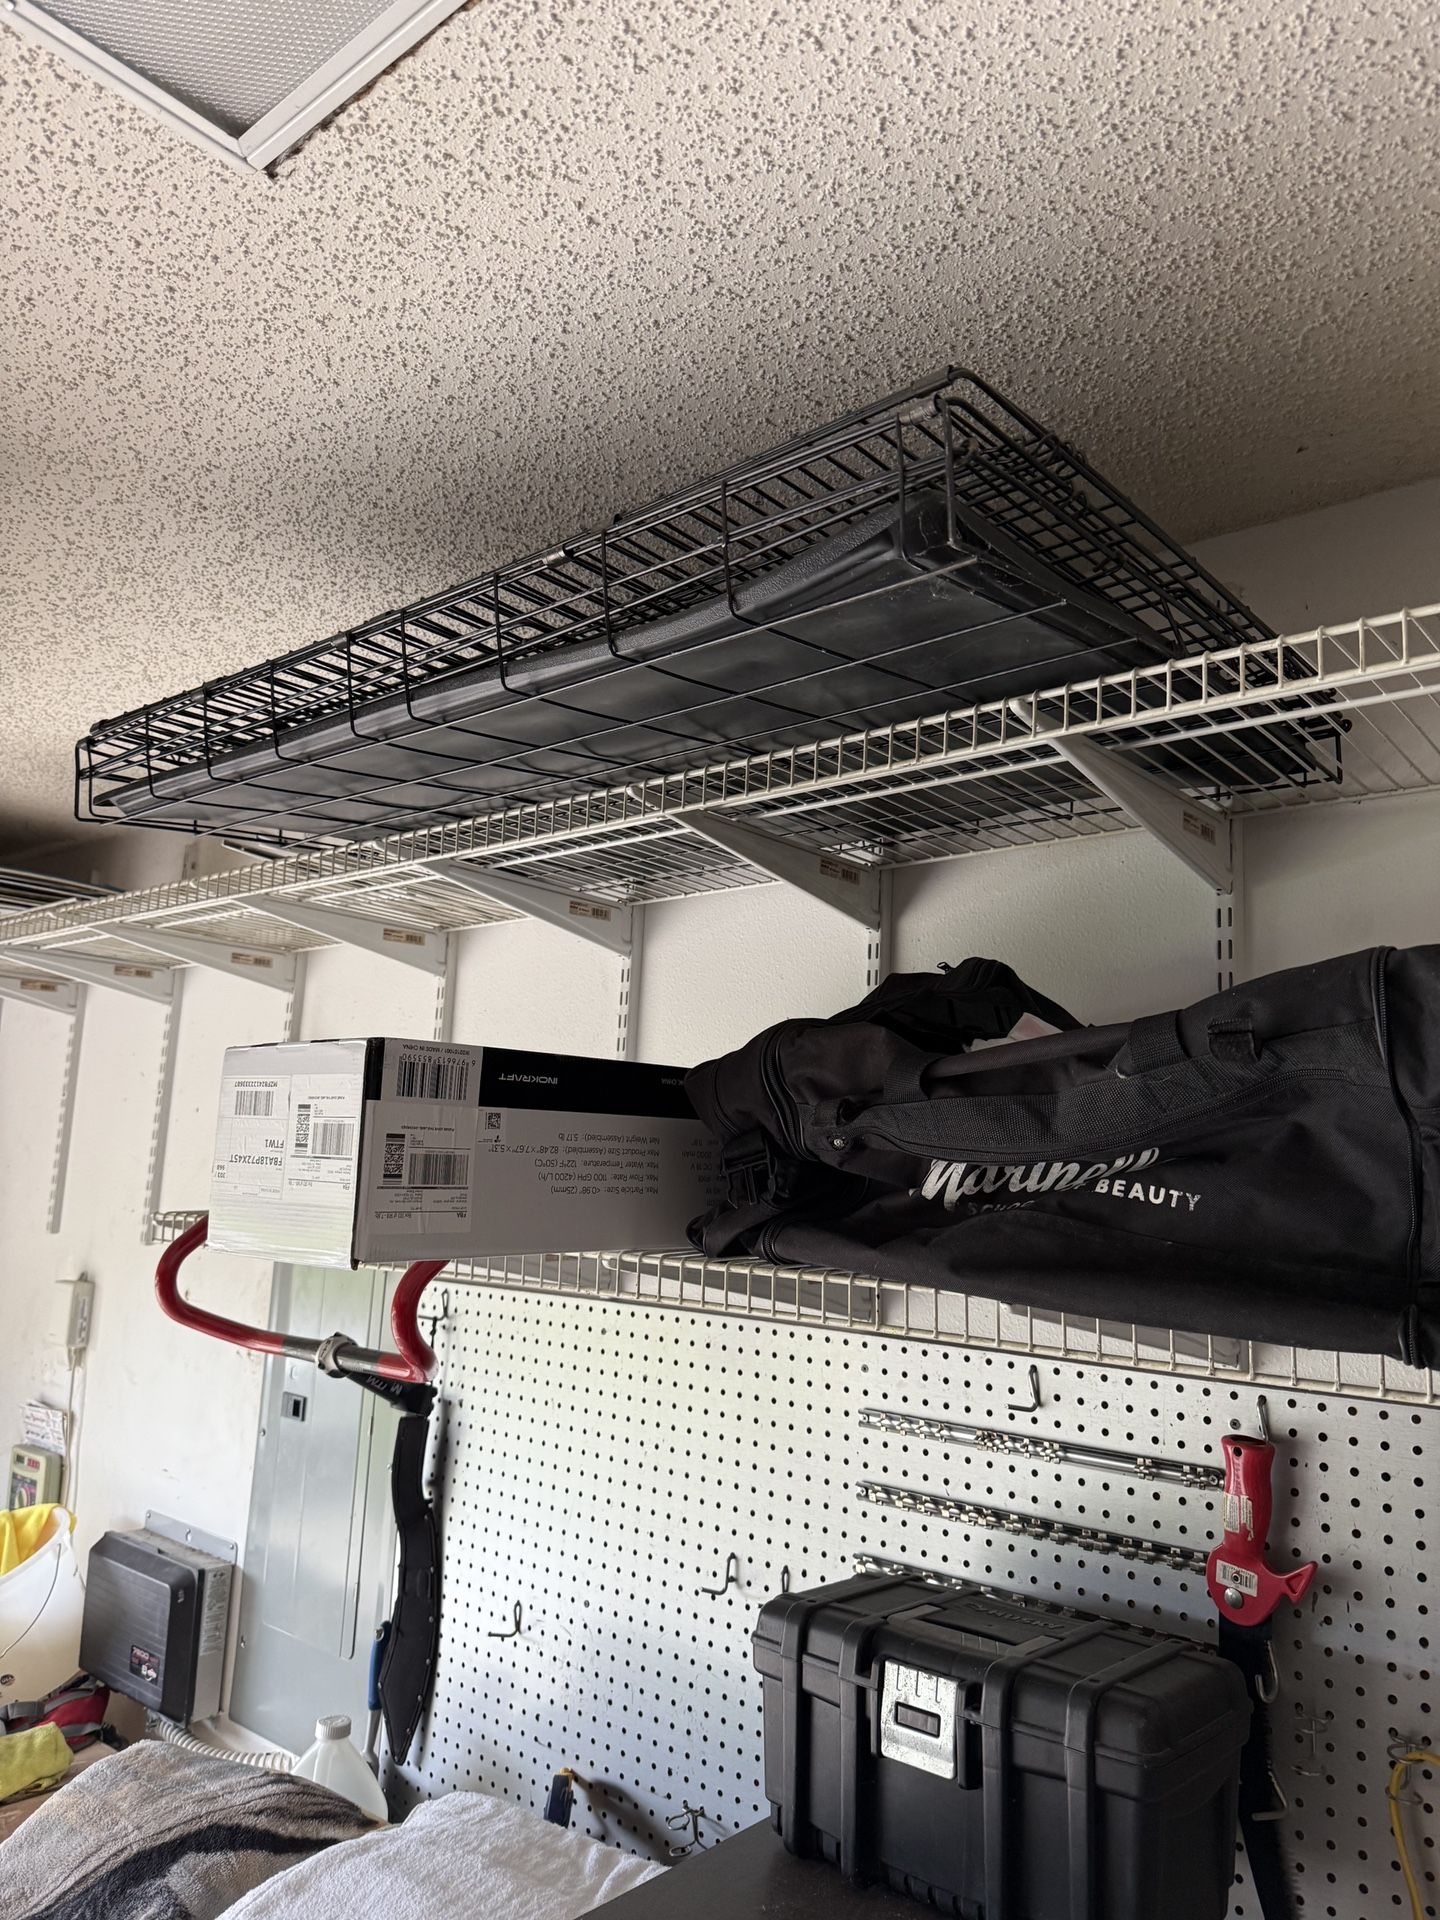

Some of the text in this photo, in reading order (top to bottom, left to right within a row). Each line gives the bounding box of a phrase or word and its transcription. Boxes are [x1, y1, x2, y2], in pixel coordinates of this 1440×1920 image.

[497, 1072, 558, 1085] INOKRAFT
[264, 1139, 285, 1149] FTW1
[626, 1135, 648, 1145] Weight
[607, 1148, 621, 1156] Size
[622, 1148, 646, 1157] Product
[228, 1154, 283, 1167] FBA18P72X45T
[534, 1159, 558, 1168] (50°C)
[625, 1161, 644, 1169] Water
[538, 1171, 554, 1181] L/h)
[554, 1172, 576, 1182] (4200
[577, 1173, 592, 1181] GPH
[628, 1174, 644, 1182] Flow
[550, 1185, 578, 1195] (25mm)
[620, 1186, 644, 1194] Particle
[1094, 1178, 1203, 1212] BEAUTY
